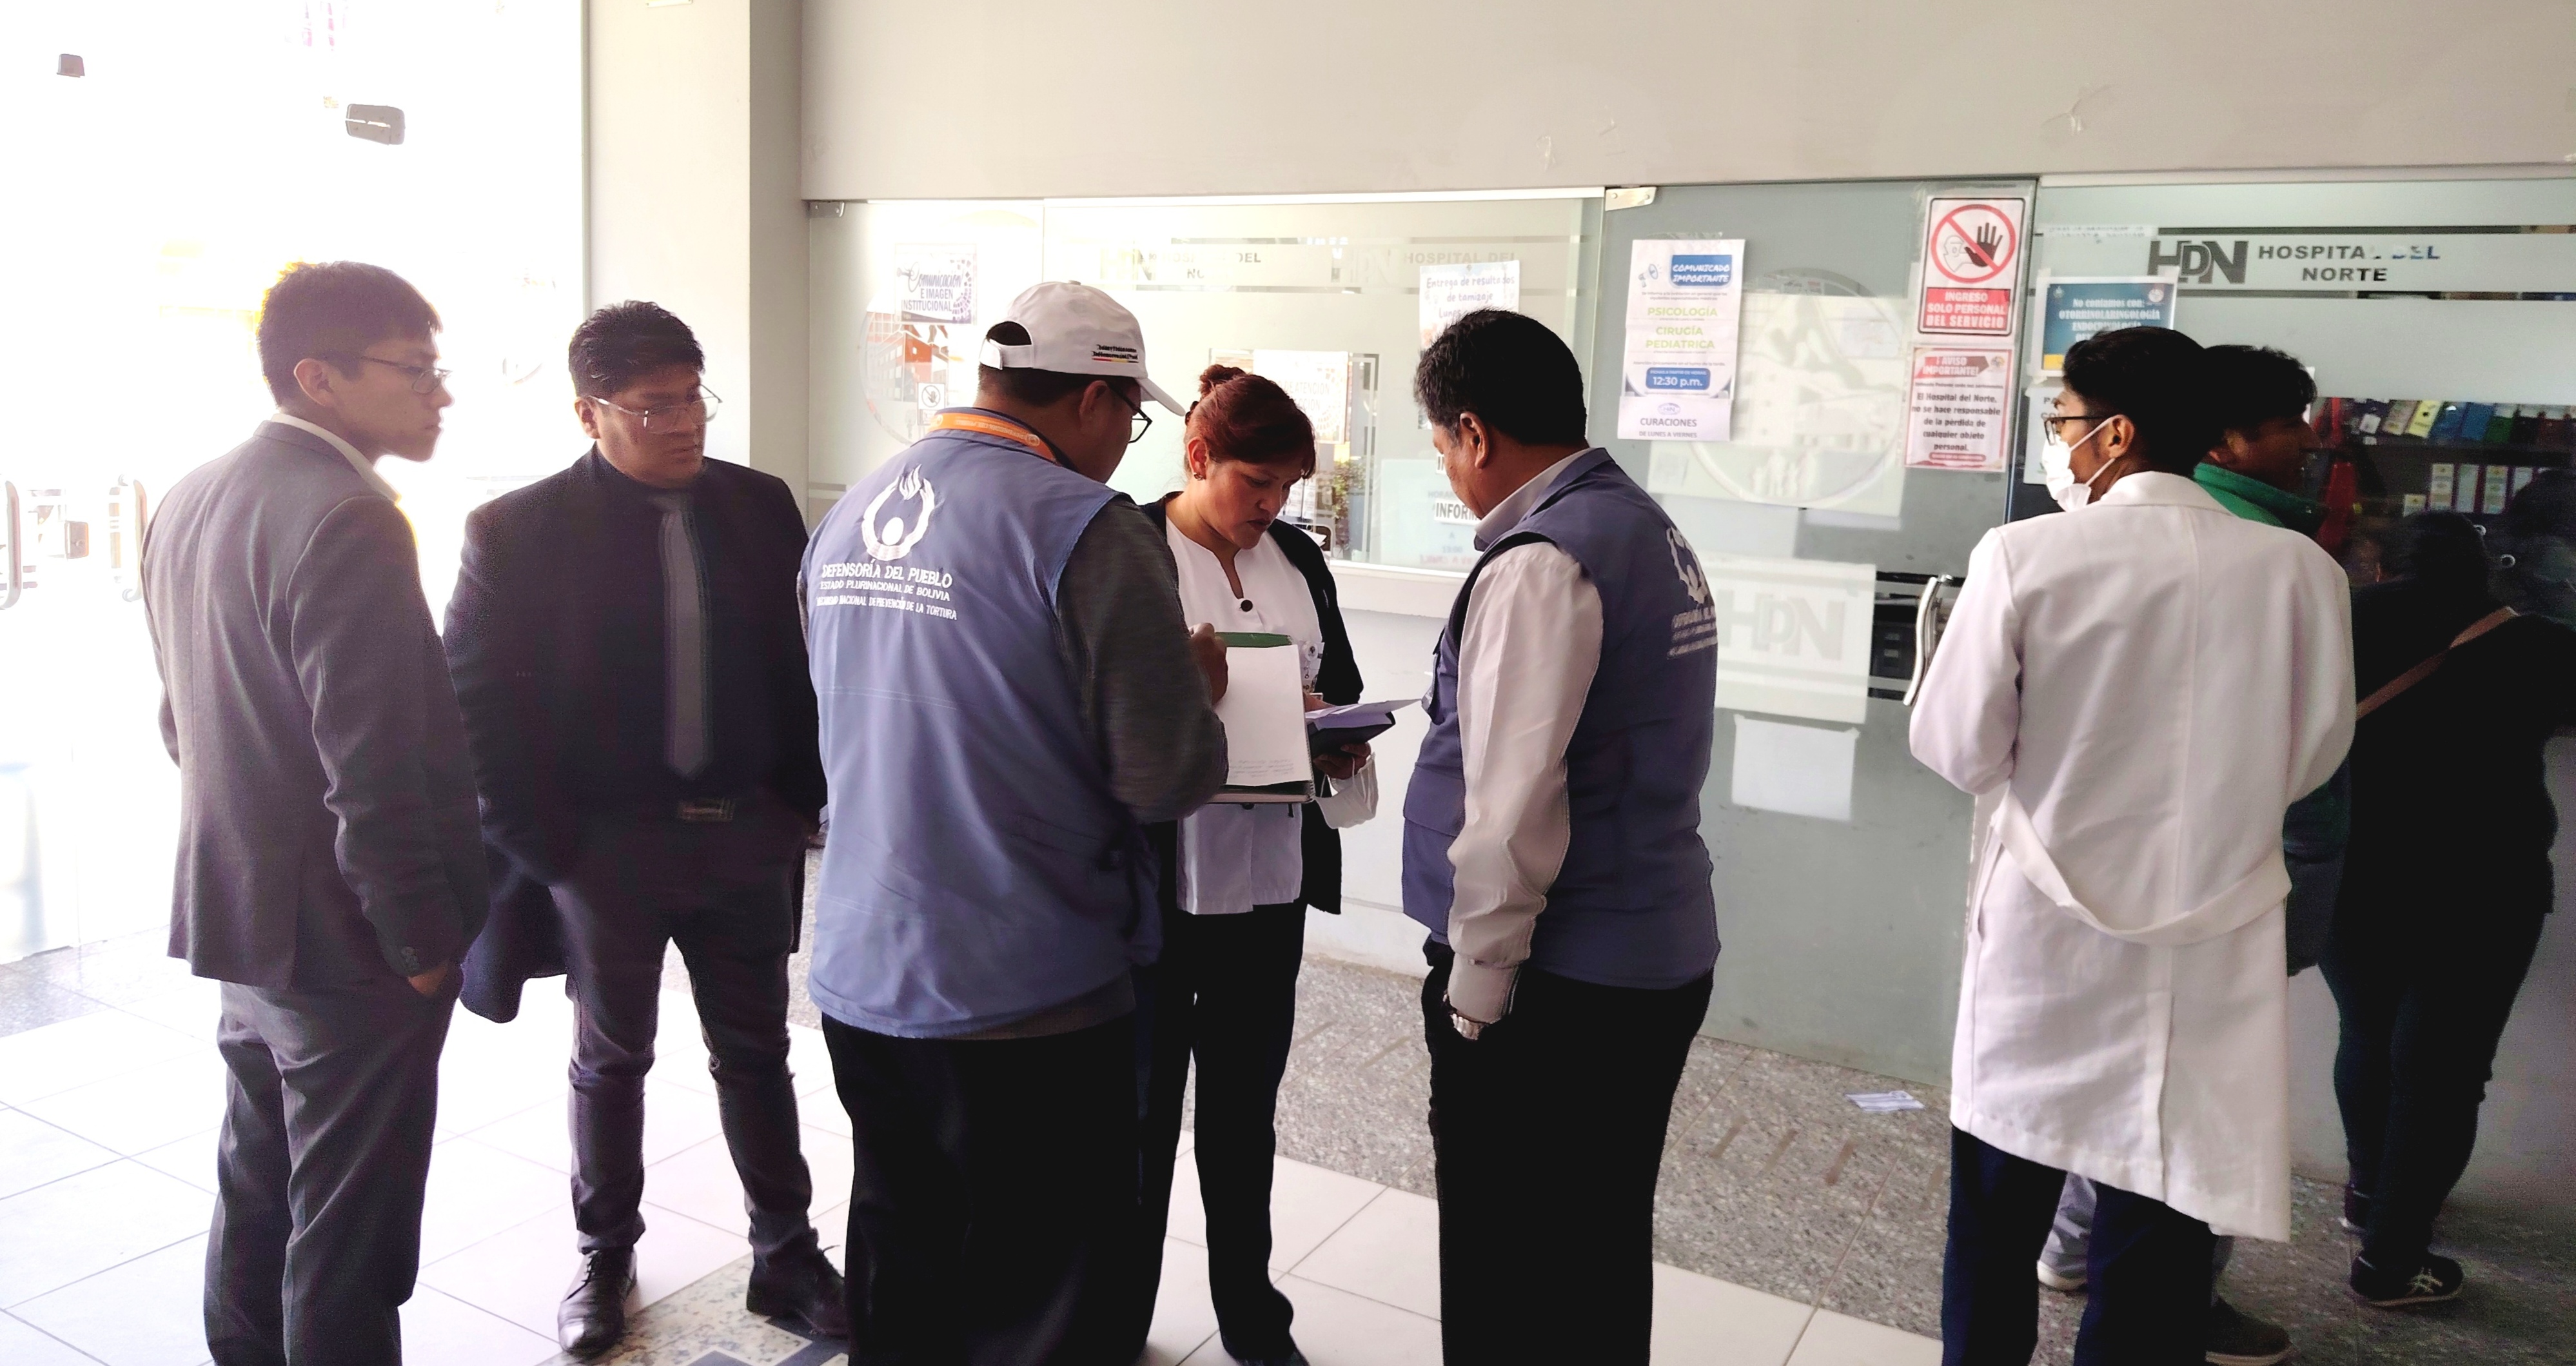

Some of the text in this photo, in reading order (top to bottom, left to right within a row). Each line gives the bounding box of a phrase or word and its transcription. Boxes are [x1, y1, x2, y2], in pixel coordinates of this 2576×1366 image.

[1403, 252, 1482, 264] HOSPITAL
[2147, 241, 2248, 284] HDN
[2258, 245, 2381, 259] HOSPITA
[2302, 267, 2388, 281] NORTE
[1426, 277, 1459, 290] Entrega
[1460, 276, 1470, 286] de
[921, 288, 953, 299] E IMAGEN
[1447, 292, 1493, 304] de tamizaje
[1945, 292, 1988, 302] INGRESO
[1927, 302, 2005, 315] SOLO PERSONAL
[2072, 299, 2084, 308] No
[2085, 299, 2125, 308] contamos
[1647, 306, 1718, 316] PSICOLOGÍA
[1925, 314, 2004, 328] DEL SERVICIO
[1655, 326, 1704, 335] CIRUGÍA
[1646, 340, 1715, 349] PEDIATRICA
[1942, 357, 1967, 366] AVISO
[1653, 377, 1703, 388] 12:30 p.m.
[1640, 418, 1697, 427] CURACIONES
[1923, 431, 1957, 439] cualquier
[822, 559, 953, 588] DEFENSORÍA DEL PUEBLO
[820, 580, 950, 602] ESTADO PLURINACIONAL DE BOLIVIA
[838, 595, 867, 606] NACIONAL
[869, 597, 876, 606] DE
[905, 601, 914, 611] DE
[916, 602, 924, 613] LA
[925, 604, 957, 620] TORTURA
